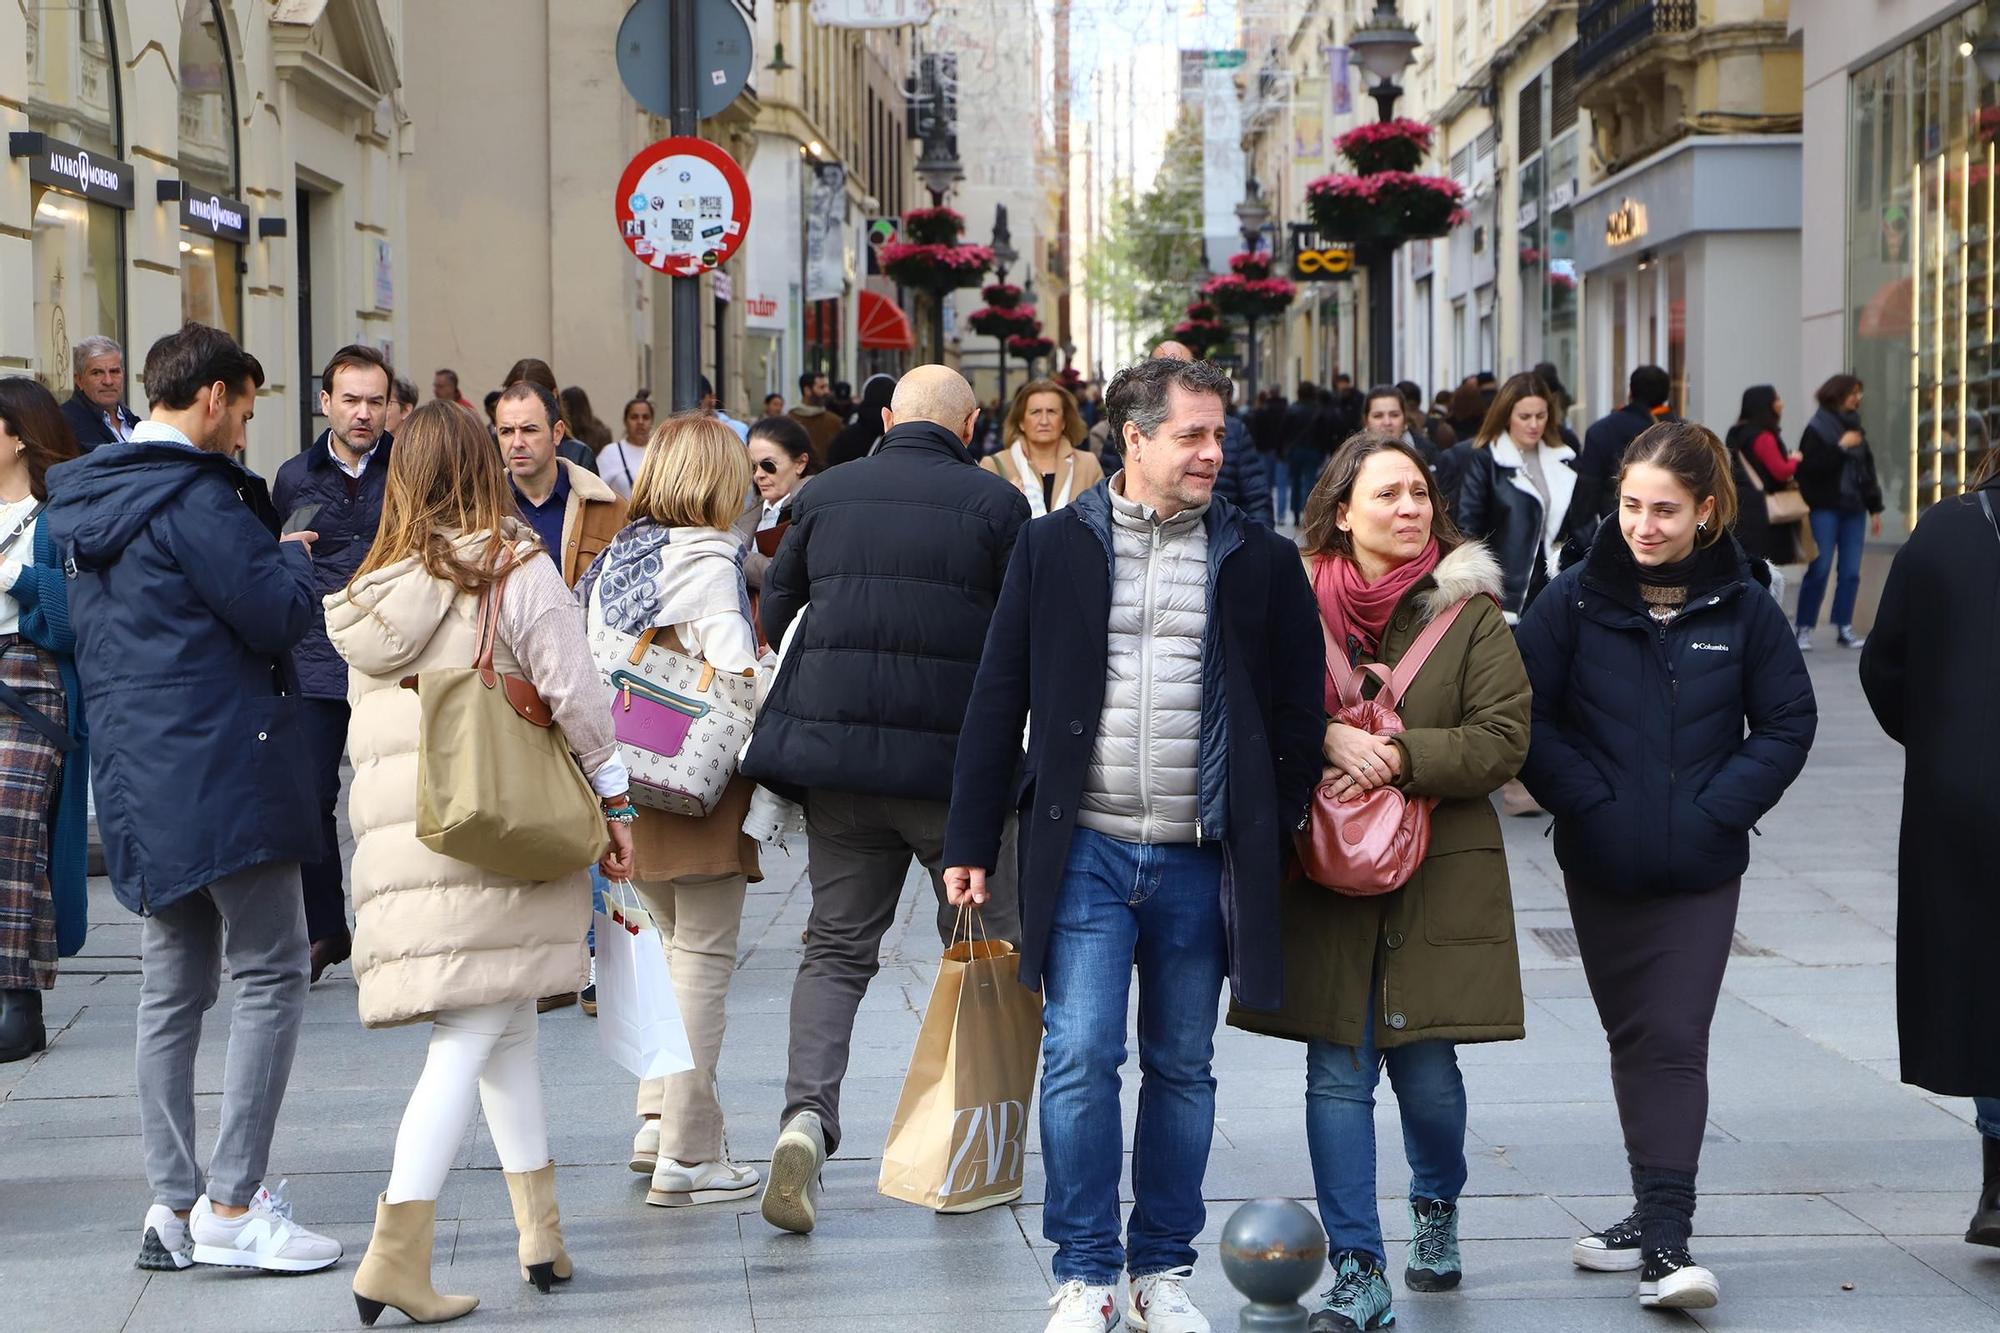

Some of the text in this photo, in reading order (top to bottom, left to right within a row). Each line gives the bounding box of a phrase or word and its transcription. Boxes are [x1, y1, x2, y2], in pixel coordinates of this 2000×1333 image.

[50, 152, 118, 192] ALVARO MORENO
[189, 198, 241, 230] ALVARO MORENO
[1699, 642, 1729, 652] Columbia
[938, 1100, 1031, 1196] ZAR
